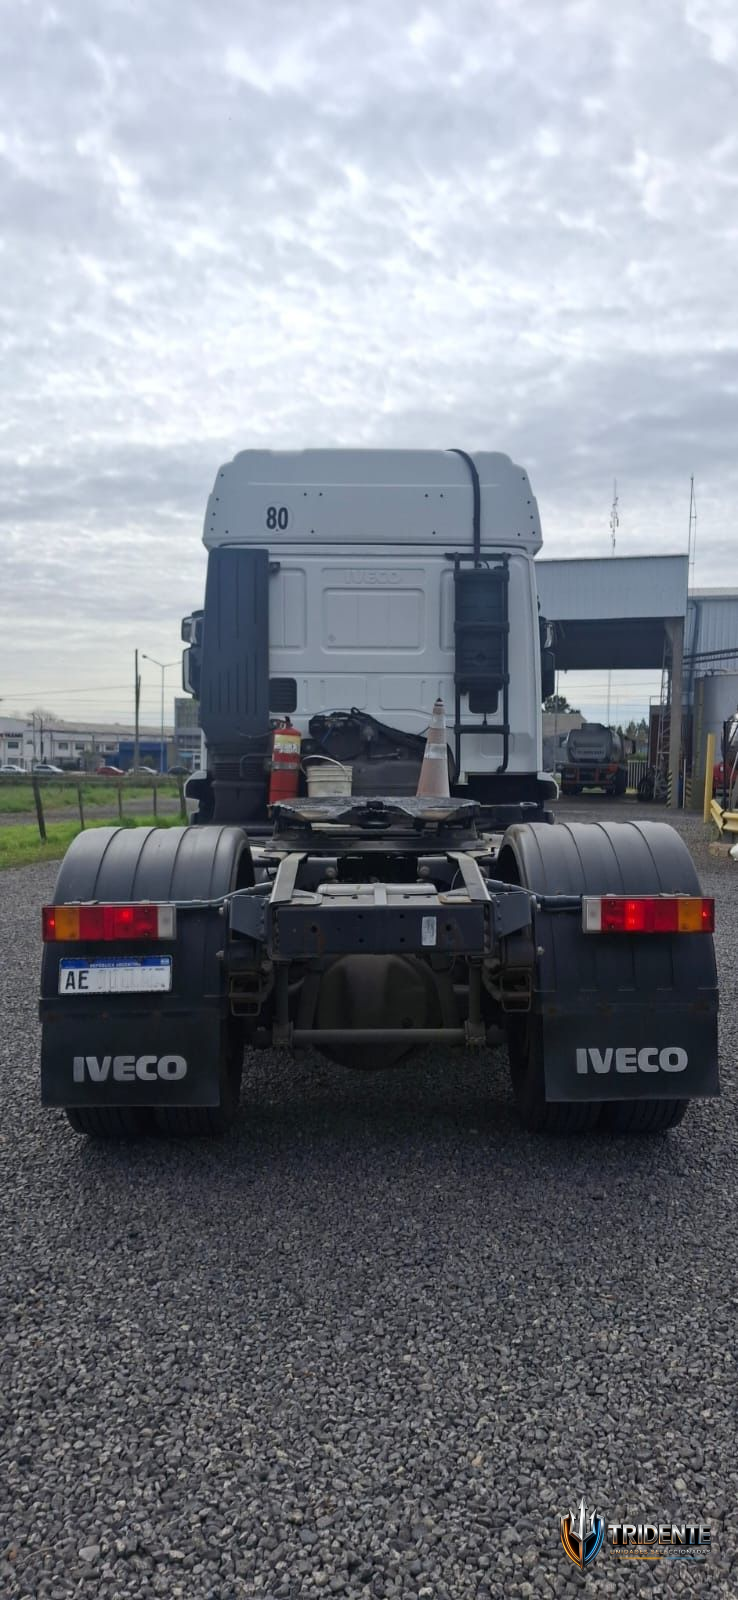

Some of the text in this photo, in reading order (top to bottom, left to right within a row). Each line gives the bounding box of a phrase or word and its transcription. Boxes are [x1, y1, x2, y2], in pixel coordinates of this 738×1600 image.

[266, 506, 289, 530] 80
[344, 569, 402, 585] IVECO
[65, 970, 89, 990] AE
[73, 1055, 187, 1082] IVECO
[576, 1047, 688, 1074] IVECO
